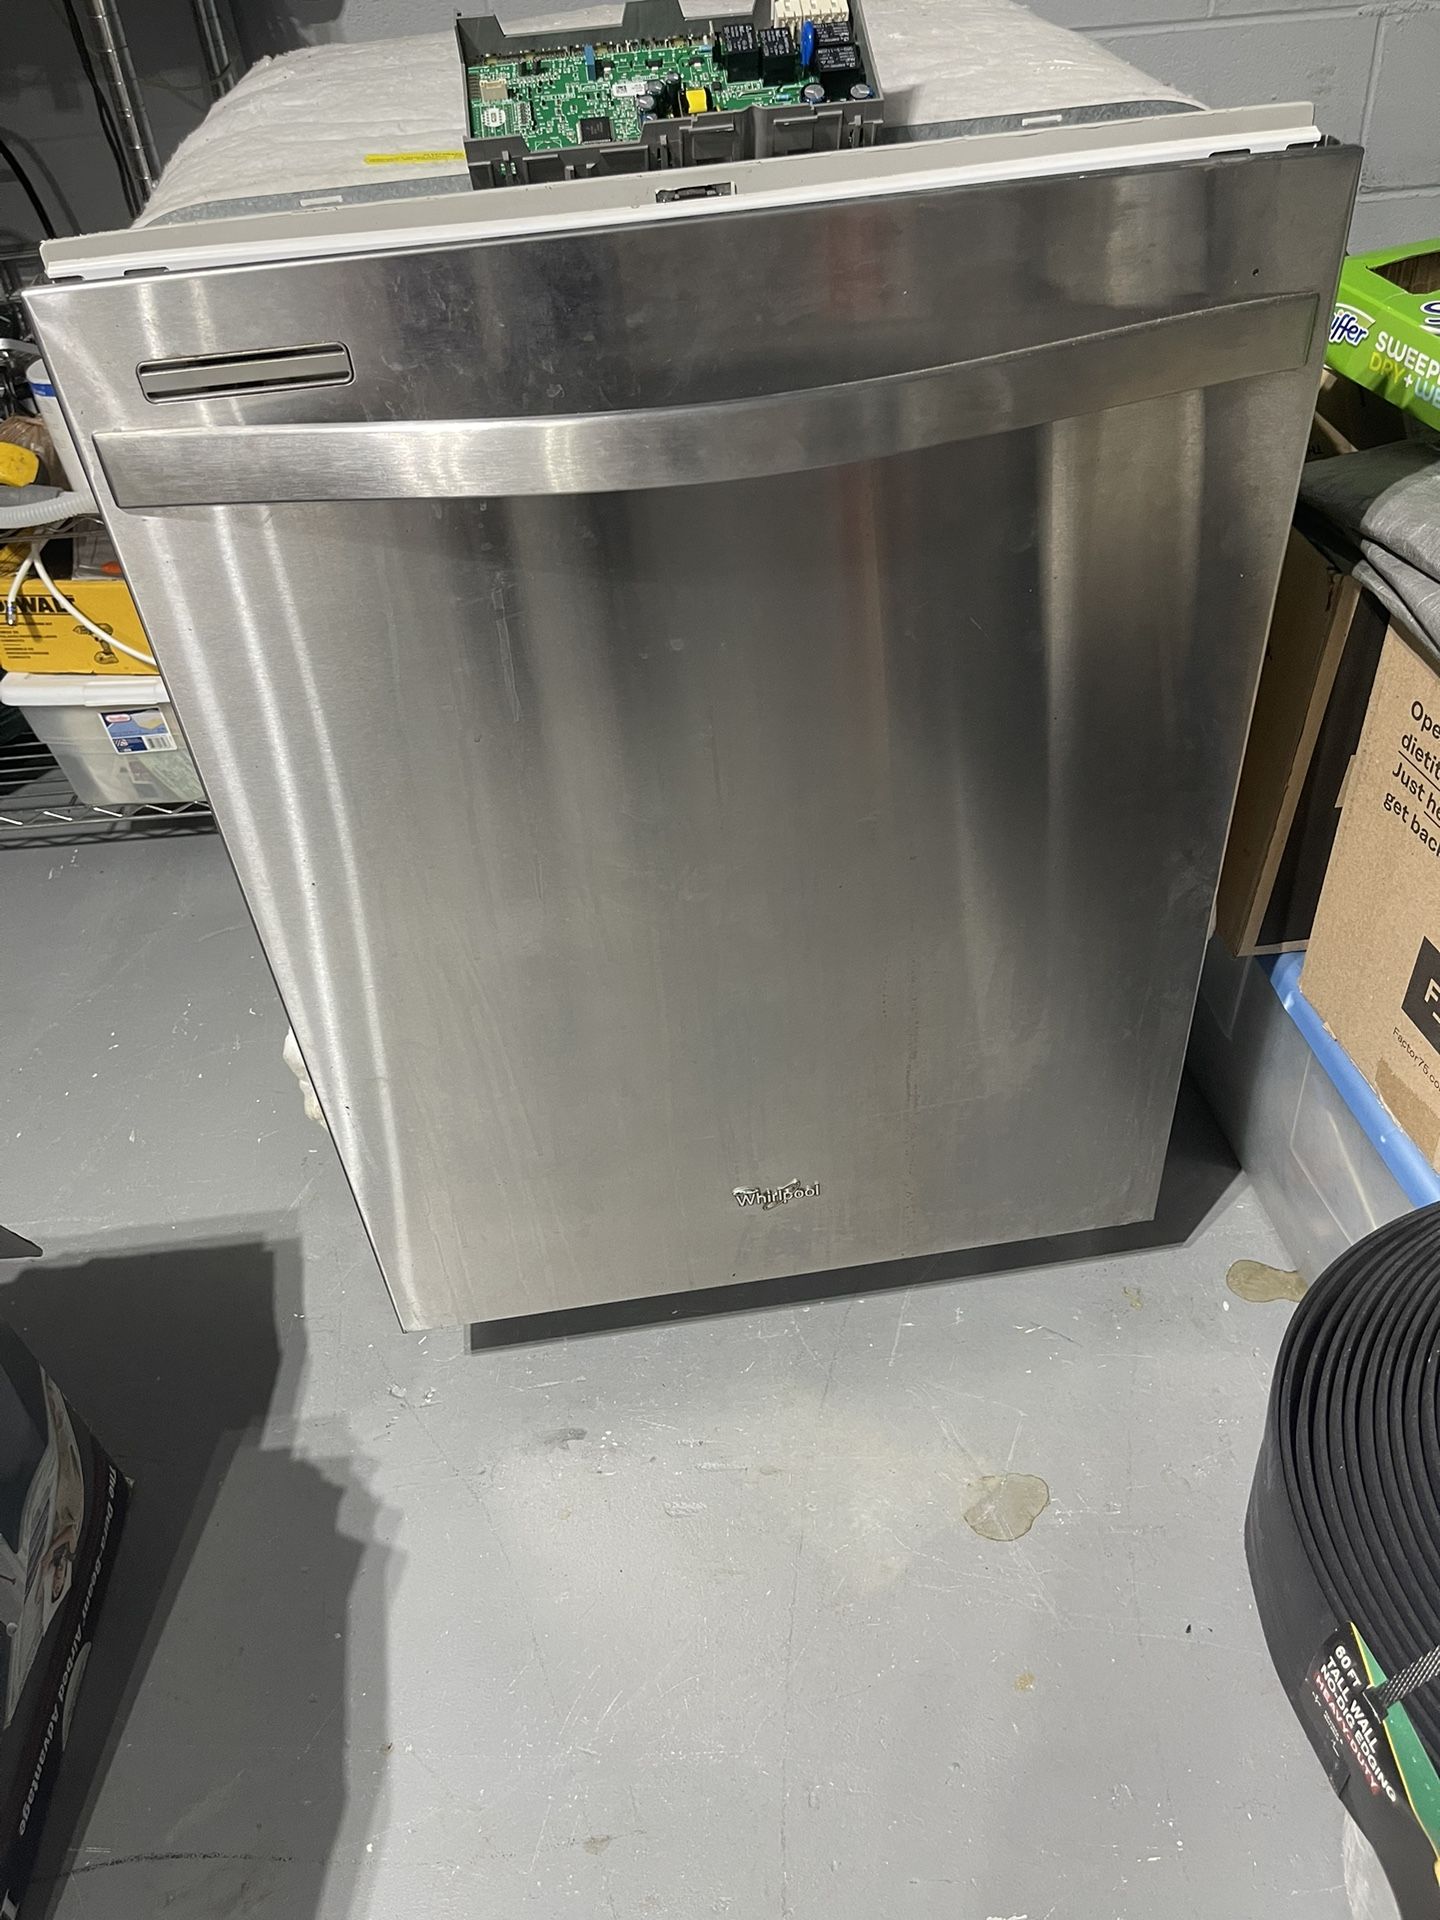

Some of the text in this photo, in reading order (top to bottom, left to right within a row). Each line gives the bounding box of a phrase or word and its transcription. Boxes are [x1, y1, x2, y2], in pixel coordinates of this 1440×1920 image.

[1369, 352, 1405, 384] DRY
[1375, 331, 1440, 385] SWEEP
[1383, 792, 1409, 823] get
[1392, 762, 1425, 802] Just
[1392, 1026, 1440, 1091] Factor75.co
[732, 1180, 820, 1208] Whirlpool
[108, 1465, 117, 1499] The
[58, 1624, 82, 1702] Airbed
[1335, 1645, 1362, 1690] 60 FT
[1315, 1674, 1379, 1789] HEAVY-DUTY
[1327, 1655, 1350, 1702] TALL
[1350, 1700, 1378, 1754] WALL
[1320, 1663, 1355, 1729] NO-DIG
[1354, 1729, 1397, 1803] EDGING
[19, 1704, 60, 1836] Advantage
